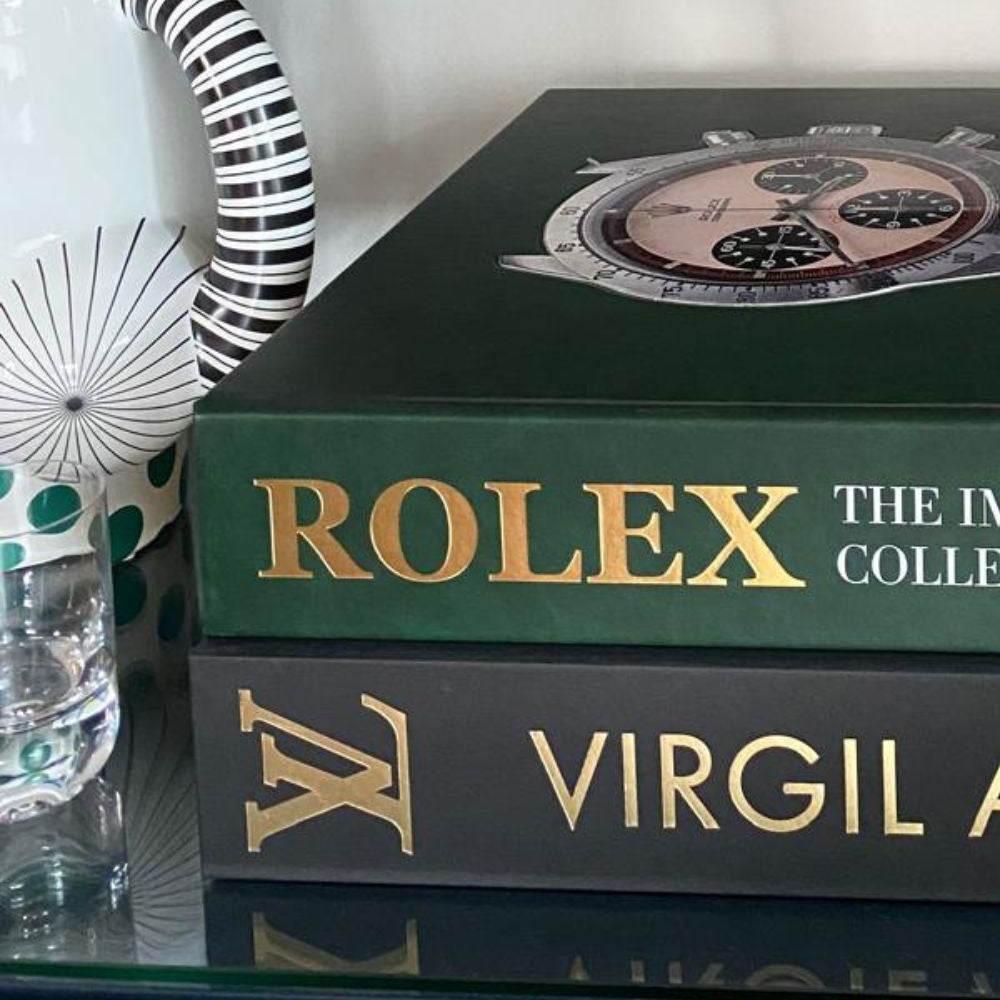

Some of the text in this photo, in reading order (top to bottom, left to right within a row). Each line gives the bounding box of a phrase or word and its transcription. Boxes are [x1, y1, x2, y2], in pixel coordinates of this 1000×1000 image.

[253, 478, 806, 588] ROLEX
[834, 485, 943, 527] THE
[529, 730, 924, 835] VIRGIL
